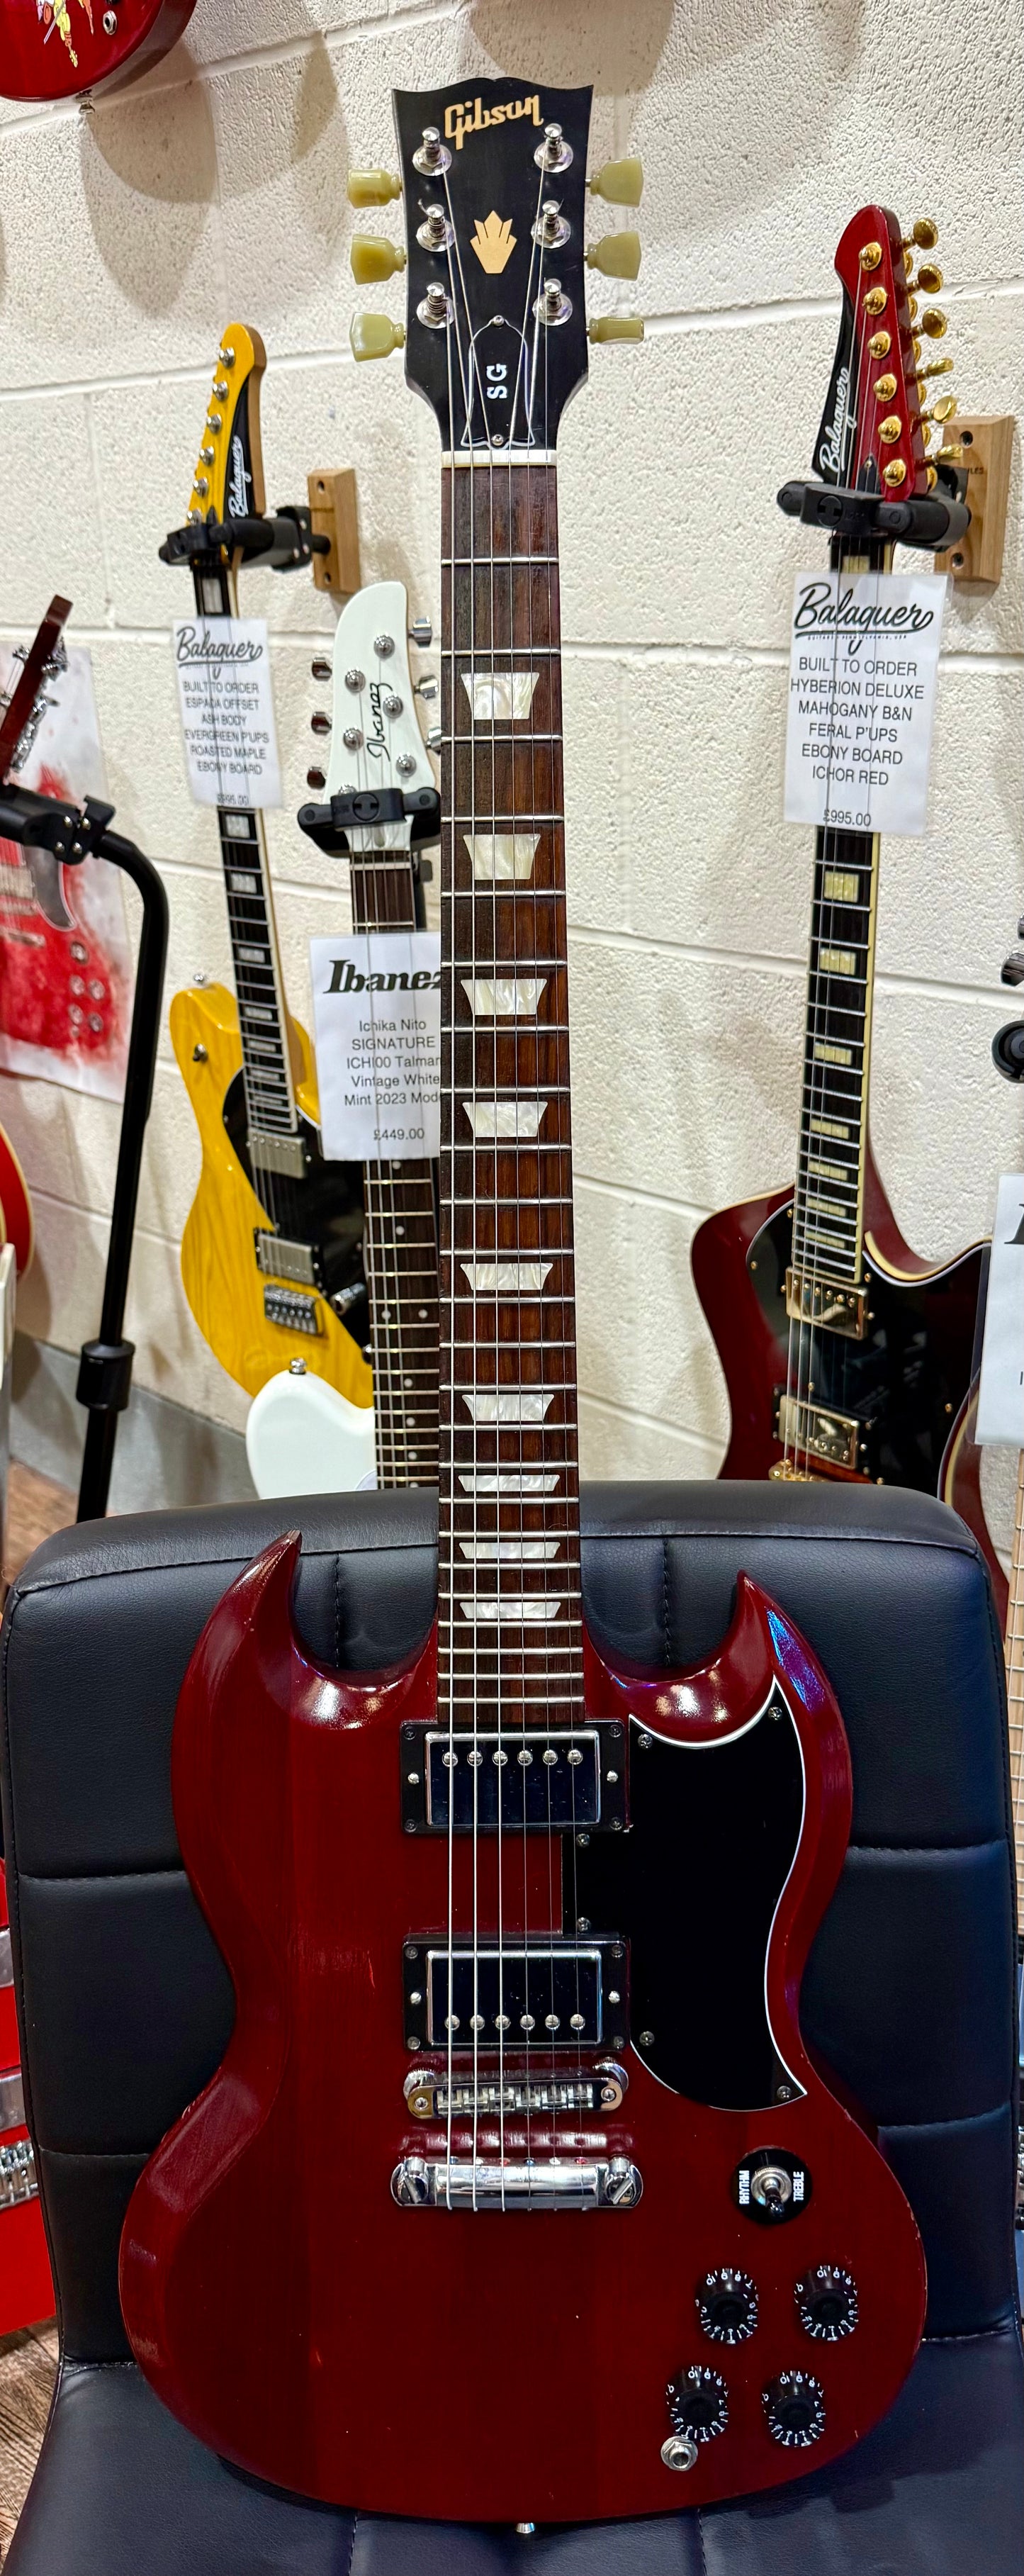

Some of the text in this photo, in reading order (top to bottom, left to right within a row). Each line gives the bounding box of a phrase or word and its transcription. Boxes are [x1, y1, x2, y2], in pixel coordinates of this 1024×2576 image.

[445, 94, 544, 150] Gibson
[486, 364, 507, 399] SG
[819, 367, 857, 472] Balaguer
[228, 435, 252, 517] Balaguer
[794, 582, 934, 656] Balaguer
[176, 626, 264, 679] Balaguer
[799, 657, 917, 676] BUILT TO ORDER
[183, 681, 259, 694] BUILT TO ORDER
[791, 678, 925, 699] HYBERION DELUXE
[186, 697, 259, 710] ESPADA OFFSET
[798, 700, 912, 721] MAHOGANY B&N
[202, 714, 247, 727] ASH BODY
[367, 683, 393, 762] Ibanez
[184, 729, 240, 741] EVERGREEN
[809, 723, 897, 743] FERAL P'UPS
[190, 745, 266, 760] ROASTED MAPLE
[802, 744, 903, 765] EBONY BOARD
[197, 761, 263, 775] EBONY BOARD
[812, 766, 889, 785] ICHOR RED
[823, 810, 871, 827] £995.00
[359, 1019, 427, 1031] Ichika Nito
[351, 1036, 436, 1051] SIGNATURE
[351, 1073, 440, 1089] Vintage White
[344, 1092, 440, 1106] Mint 2023 Mod
[373, 1128, 425, 1141] £449.00
[739, 2171, 750, 2205] RHYTHM
[793, 2171, 804, 2202] TREBLE
